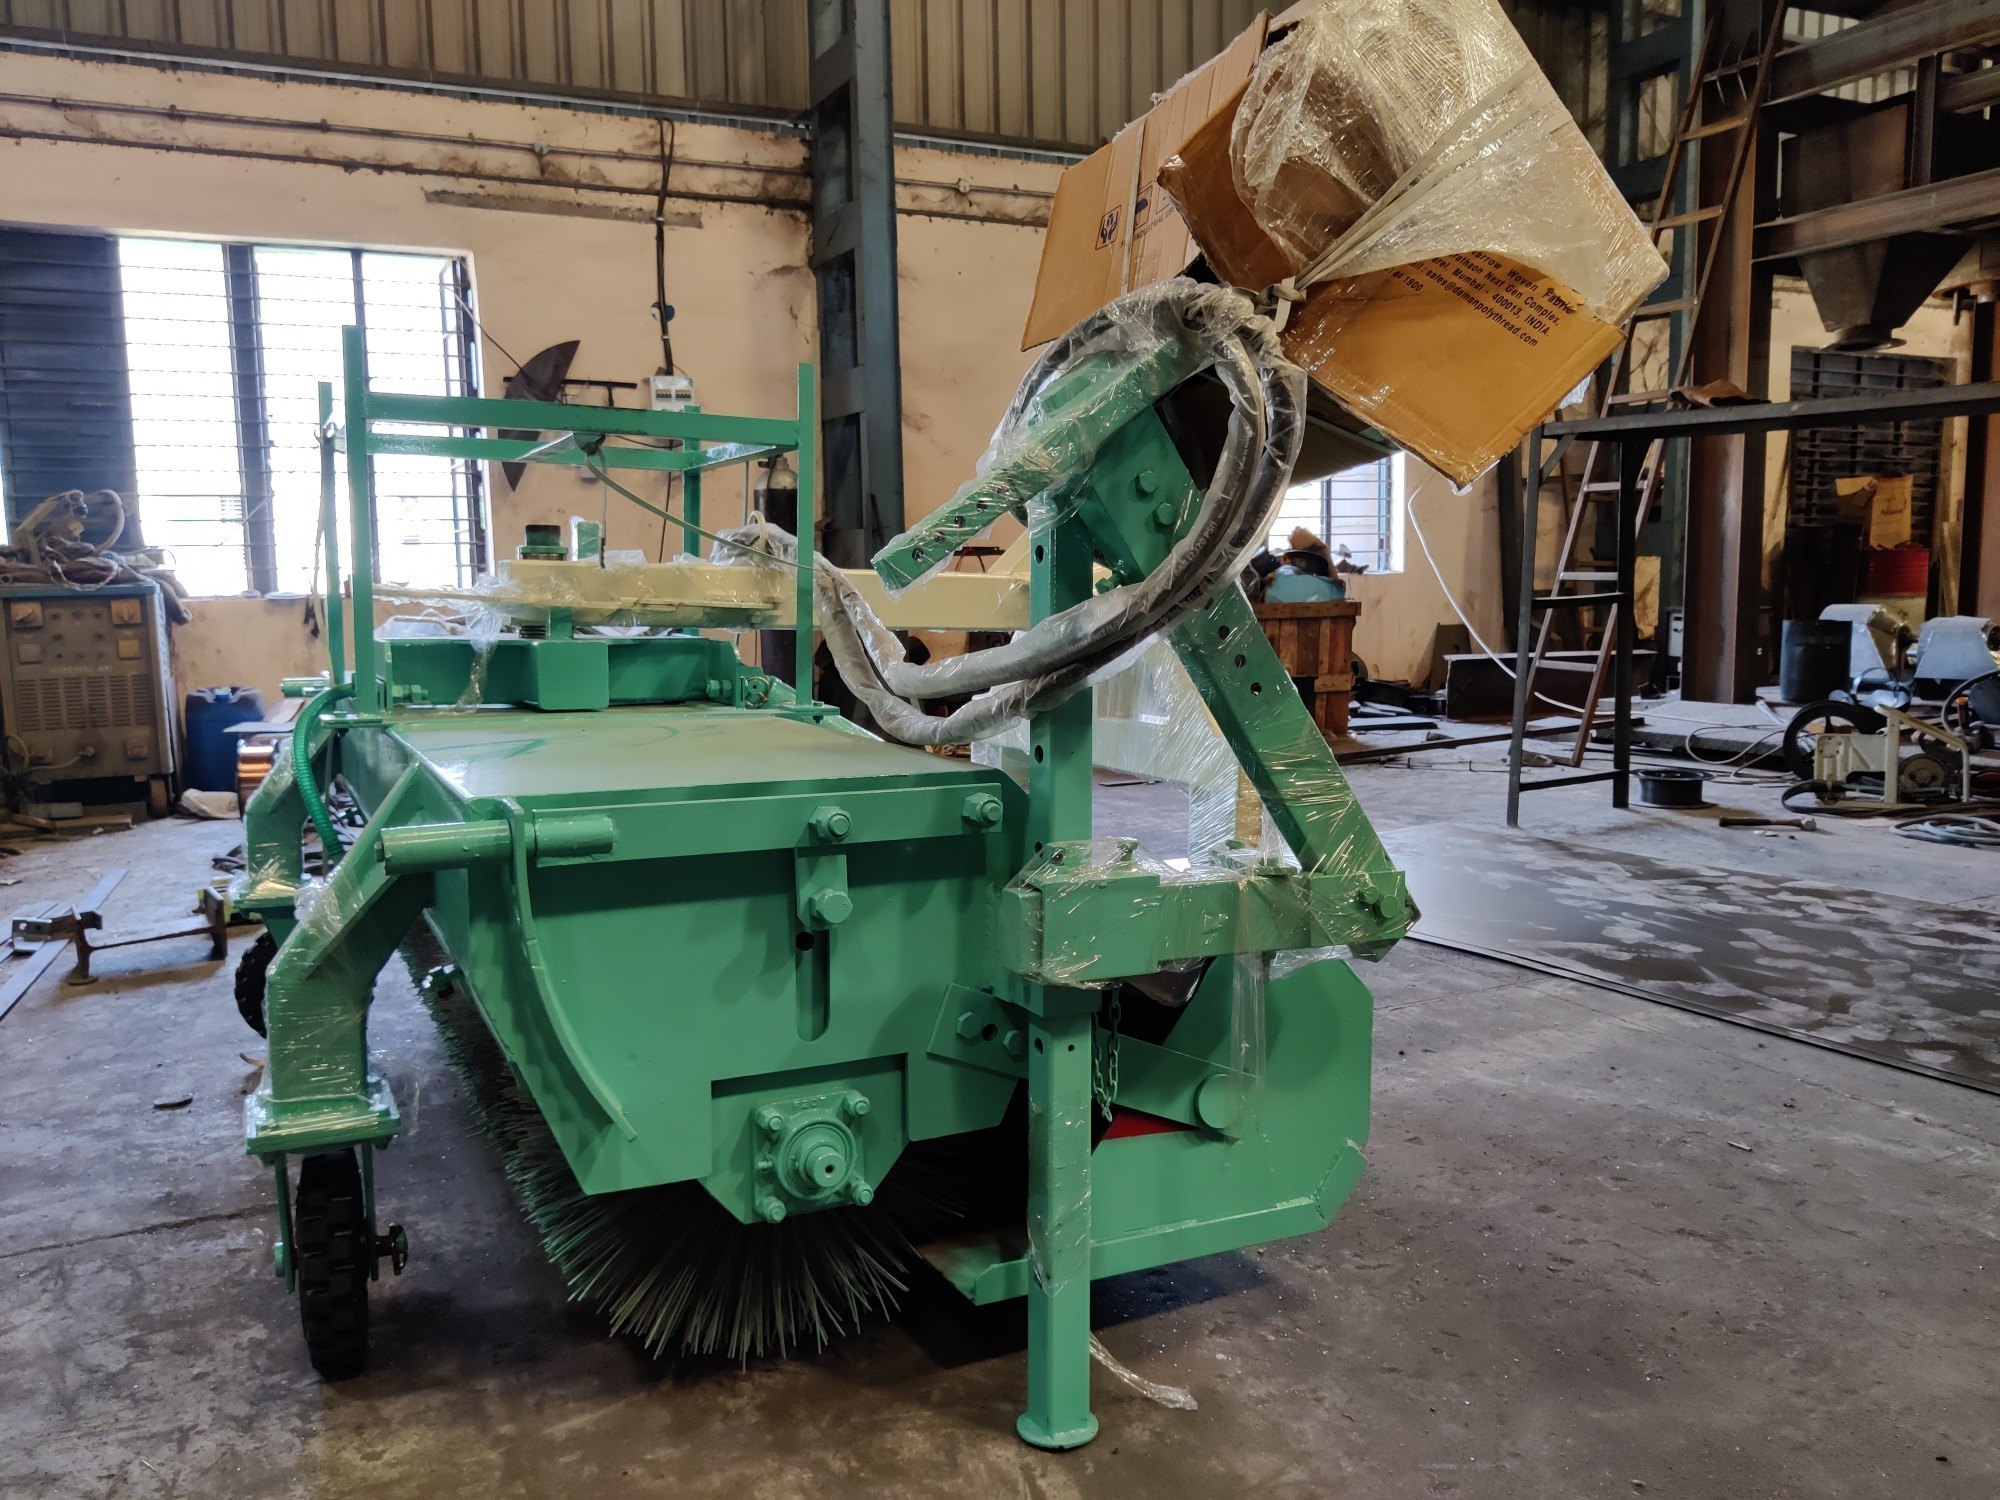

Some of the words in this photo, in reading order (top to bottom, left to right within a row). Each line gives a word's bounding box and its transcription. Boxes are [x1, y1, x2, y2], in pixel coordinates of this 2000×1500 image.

[1403, 276, 1424, 292] 1900
[1485, 271, 1506, 289] Next
[1505, 284, 1523, 299] Gen
[1524, 295, 1561, 326] Complex,
[1507, 268, 1539, 291] Woven
[1425, 268, 1539, 347] sales@damanpolythread.com
[1491, 293, 1521, 319] 400013,
[1524, 314, 1550, 338] INDIA.
[1187, 538, 1206, 561] (2320
[1204, 521, 1219, 540] PSI)
